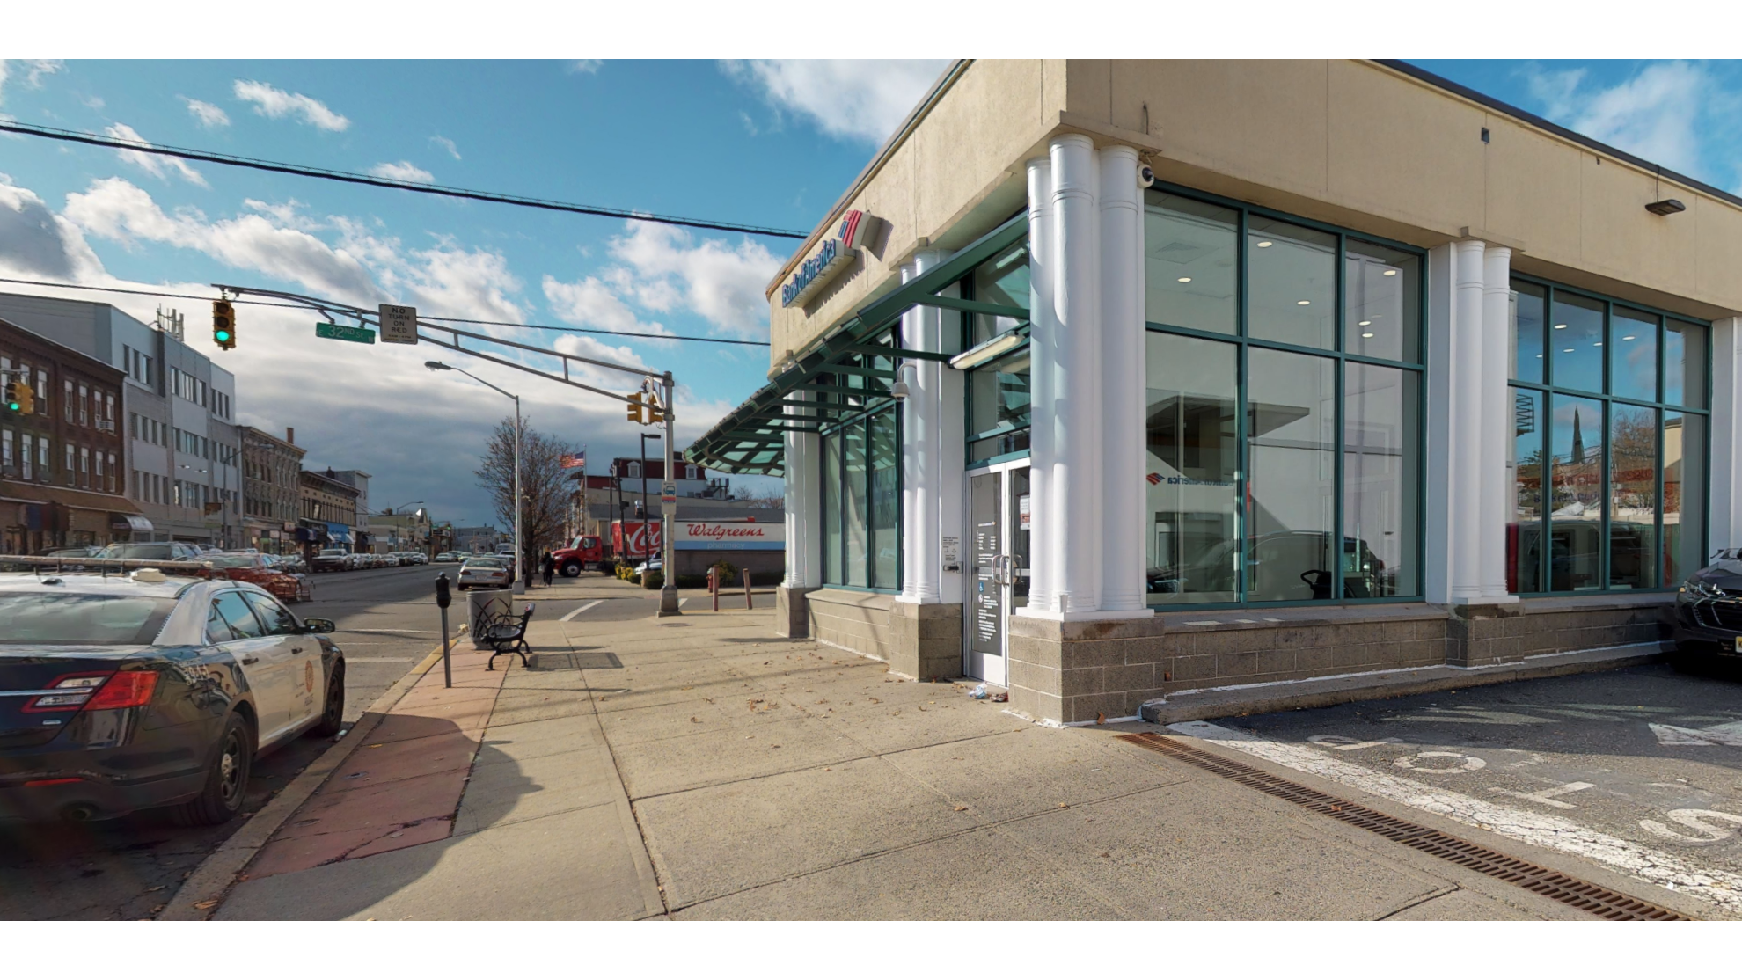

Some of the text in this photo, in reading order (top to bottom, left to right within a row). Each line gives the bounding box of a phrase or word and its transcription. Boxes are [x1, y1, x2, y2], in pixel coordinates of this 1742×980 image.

[782, 273, 799, 308] Bank
[388, 313, 410, 321] TURN
[686, 523, 765, 540] Walgreens
[707, 541, 745, 550] pharmacy
